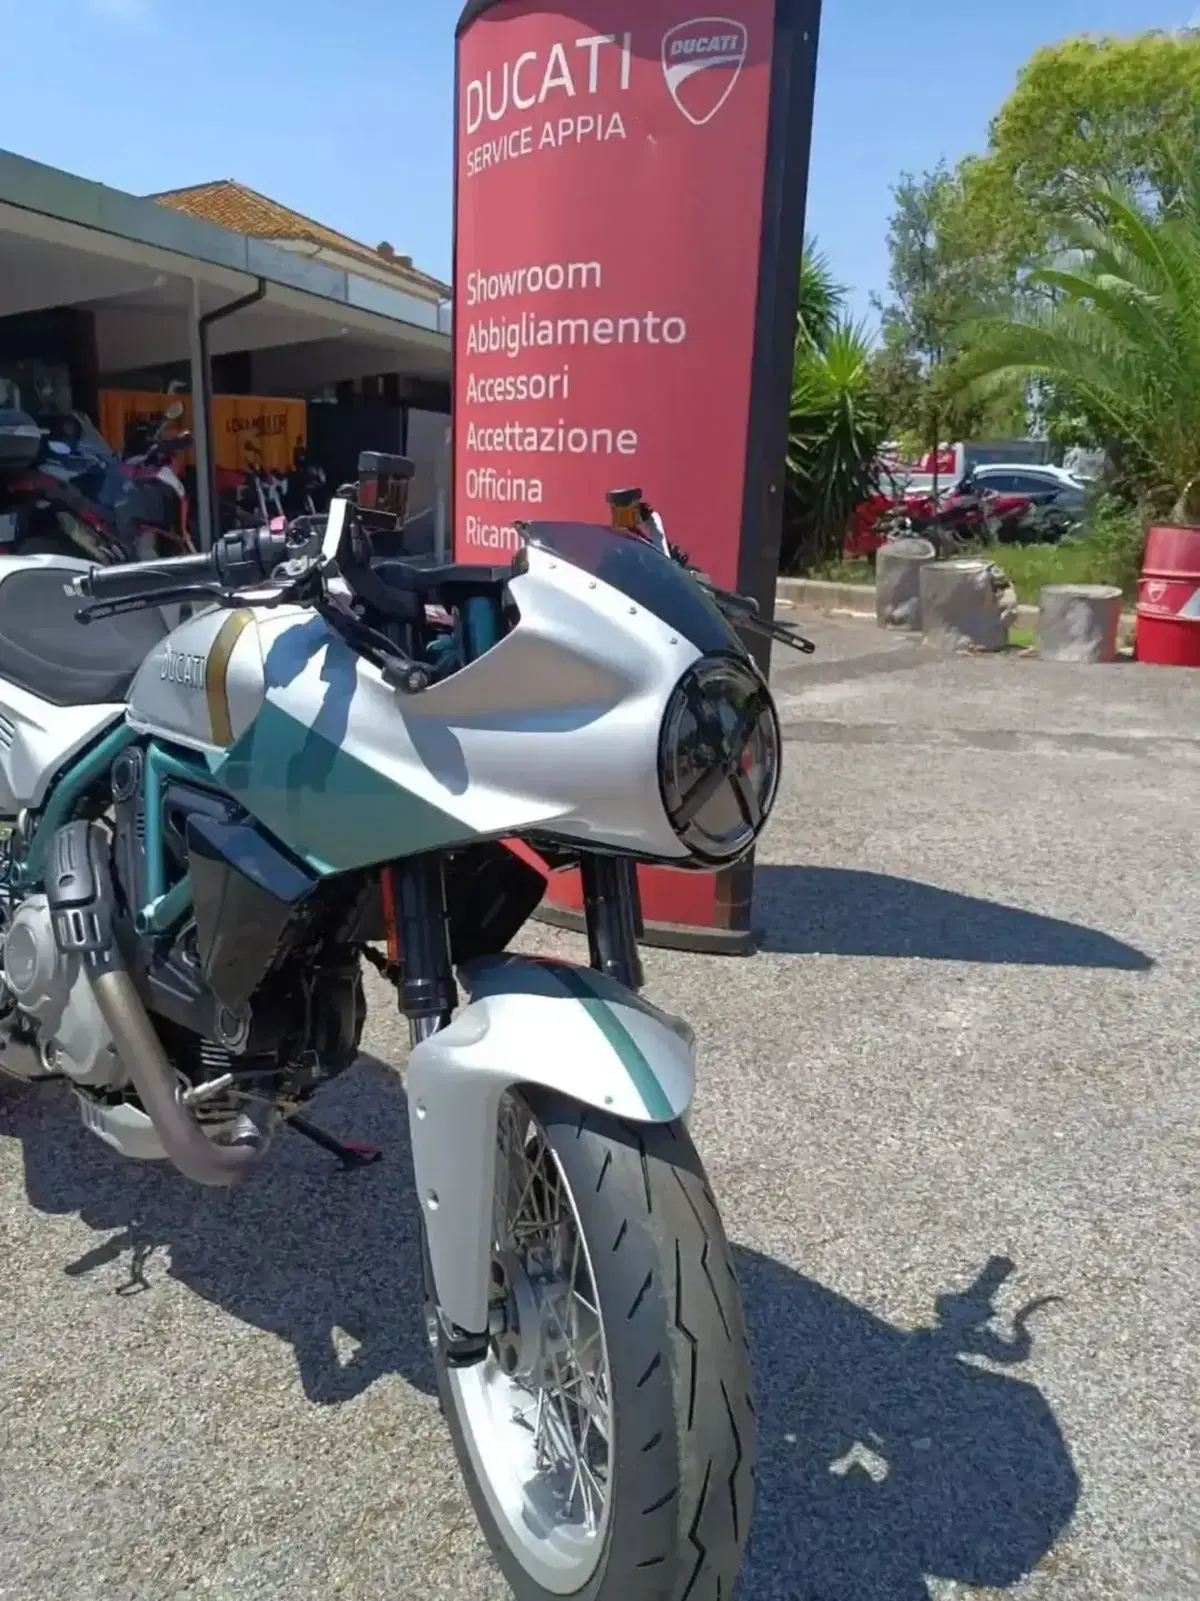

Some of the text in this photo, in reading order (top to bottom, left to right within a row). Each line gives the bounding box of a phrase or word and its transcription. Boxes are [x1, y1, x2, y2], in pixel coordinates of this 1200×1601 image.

[670, 35, 738, 57] DUCATI
[466, 31, 632, 135] DUCATI
[467, 111, 627, 177] SERVICE APPIA
[466, 261, 601, 305] Showroom
[466, 310, 687, 358] Abbigliamento
[466, 364, 569, 405] Accessori
[466, 418, 638, 454] Accettazione
[465, 467, 543, 503] Officina
[159, 650, 205, 689] DUCATI
